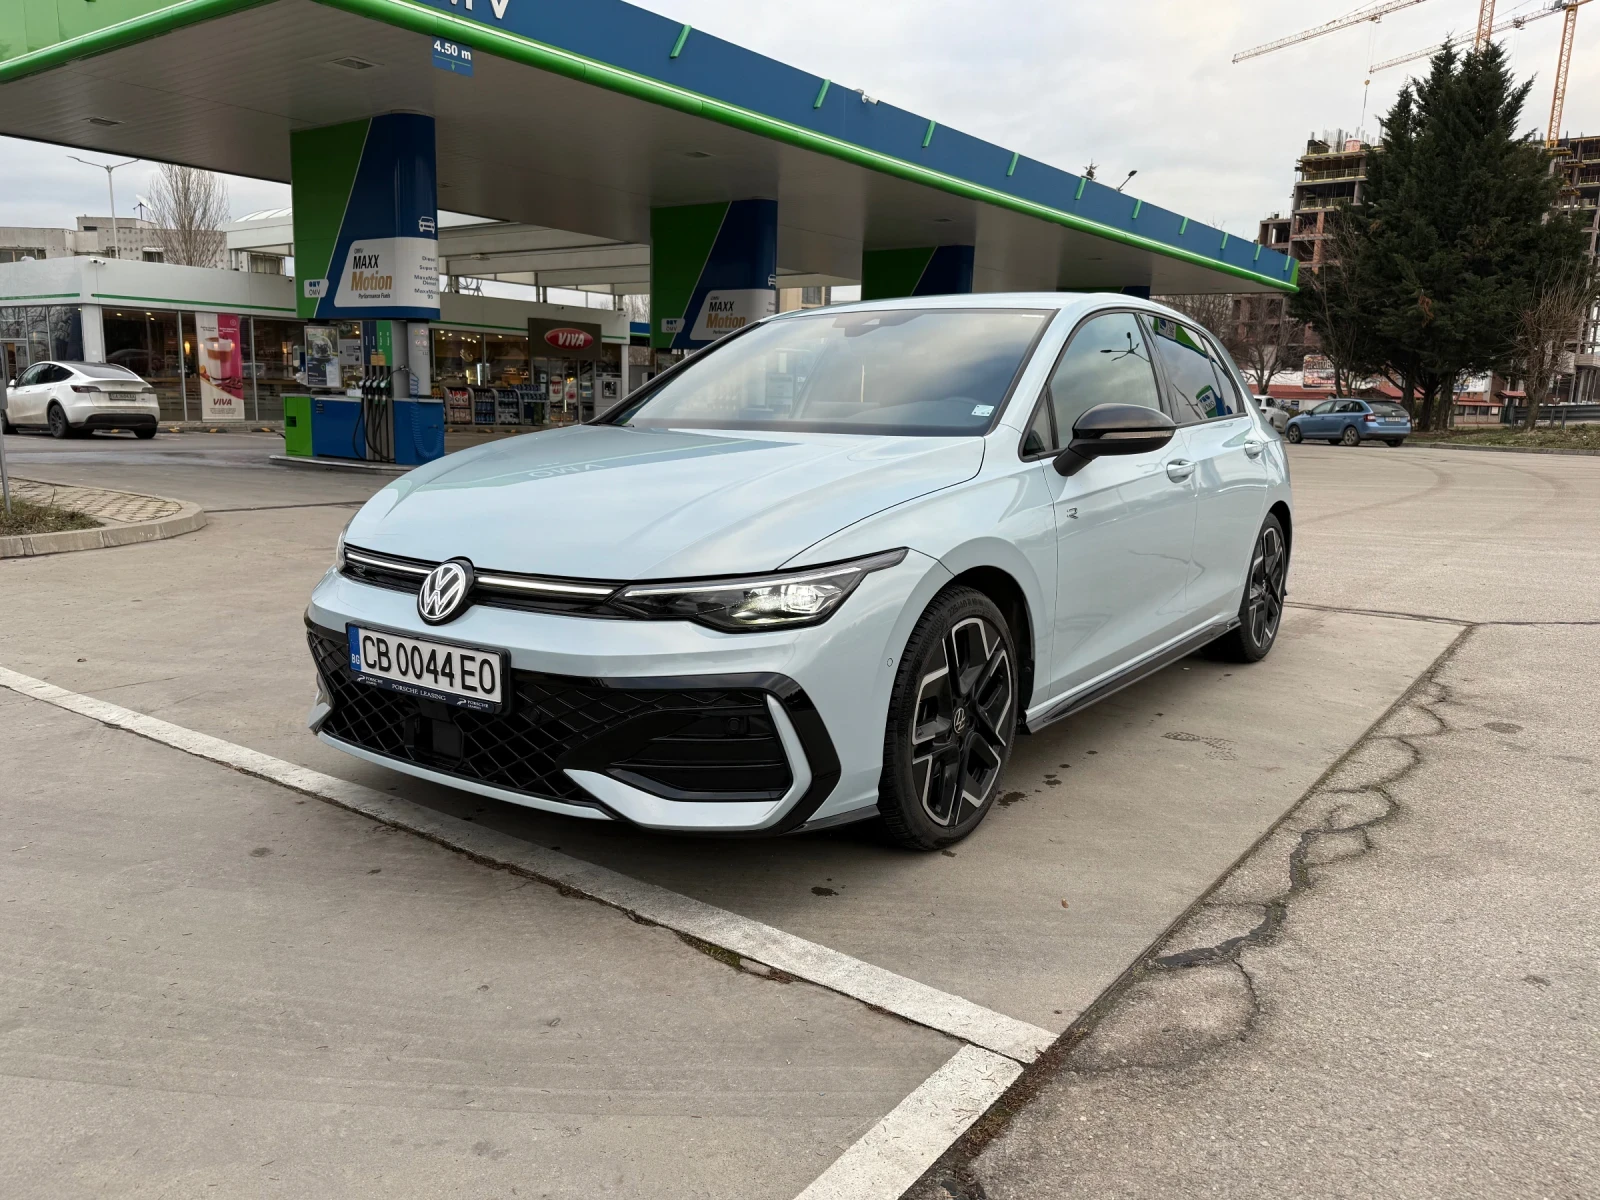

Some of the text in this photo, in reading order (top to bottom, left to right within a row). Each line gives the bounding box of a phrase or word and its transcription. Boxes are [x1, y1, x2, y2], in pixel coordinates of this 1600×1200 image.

[433, 40, 471, 60] 4.50 m
[352, 254, 380, 269] MAXX
[351, 271, 393, 291] Motion
[708, 301, 735, 312] MAXX
[705, 313, 746, 329] Motion
[557, 333, 585, 347] VIVA
[213, 398, 232, 406] VIVA
[351, 653, 360, 665] BG
[362, 635, 392, 672] CB
[396, 642, 455, 688] 0044
[391, 683, 447, 701] PORSCHE LEASING
